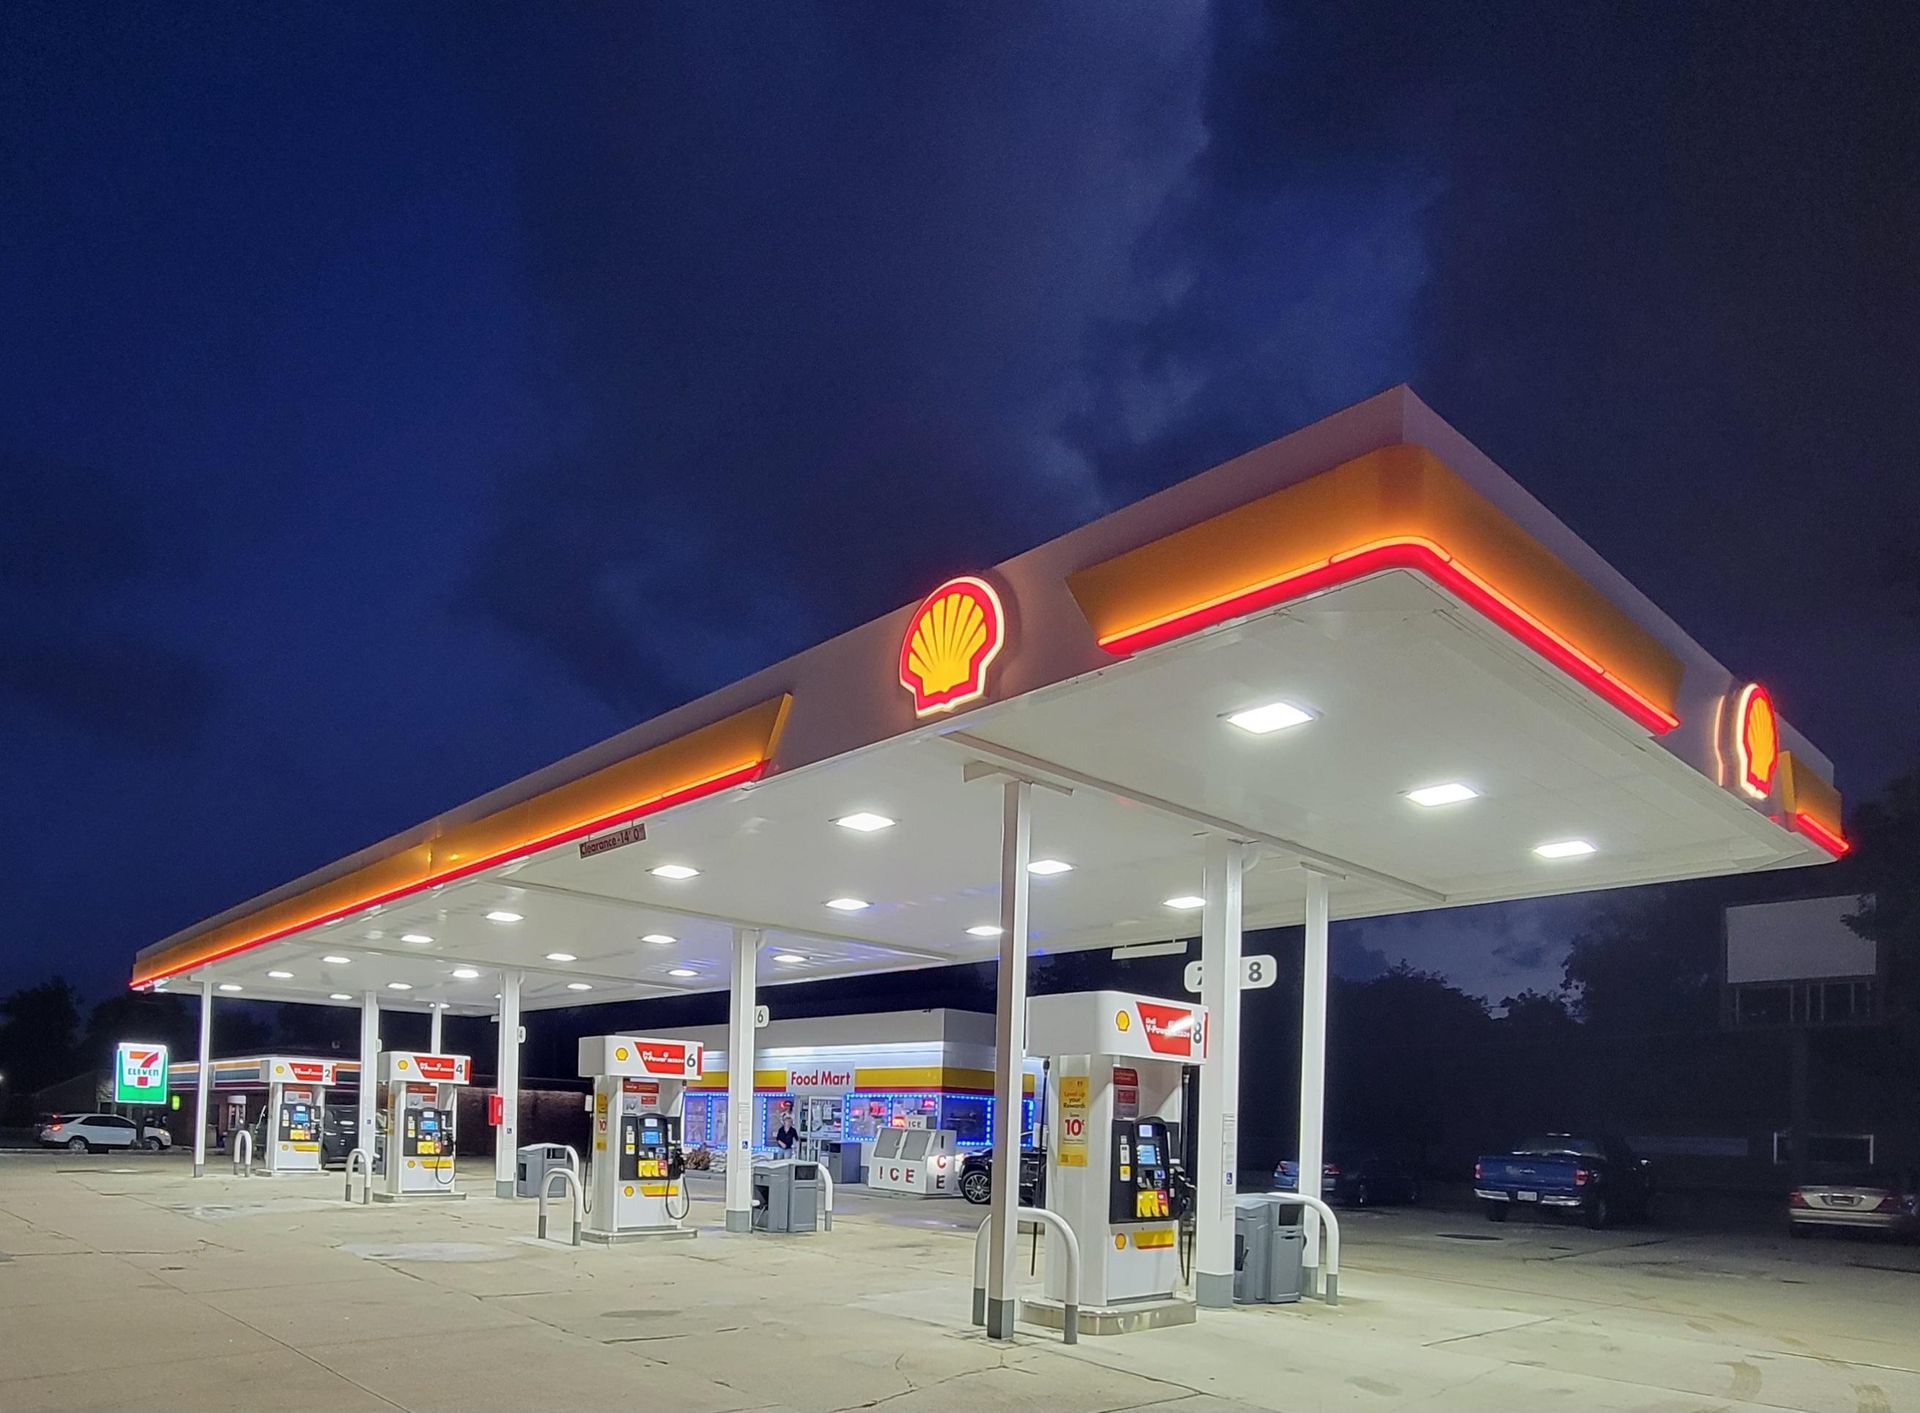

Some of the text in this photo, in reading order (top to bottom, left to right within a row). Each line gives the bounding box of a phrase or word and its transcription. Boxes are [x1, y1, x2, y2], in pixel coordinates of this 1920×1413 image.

[581, 837, 617, 855] Clearance
[1248, 961, 1262, 982] 8
[757, 1010, 764, 1023] 6
[1193, 1022, 1202, 1044] 8
[686, 1053, 696, 1067] 6
[324, 1069, 331, 1078] 2
[456, 1064, 463, 1075] 4
[791, 1070, 850, 1086] Food Mart
[879, 1166, 916, 1184] ICE
